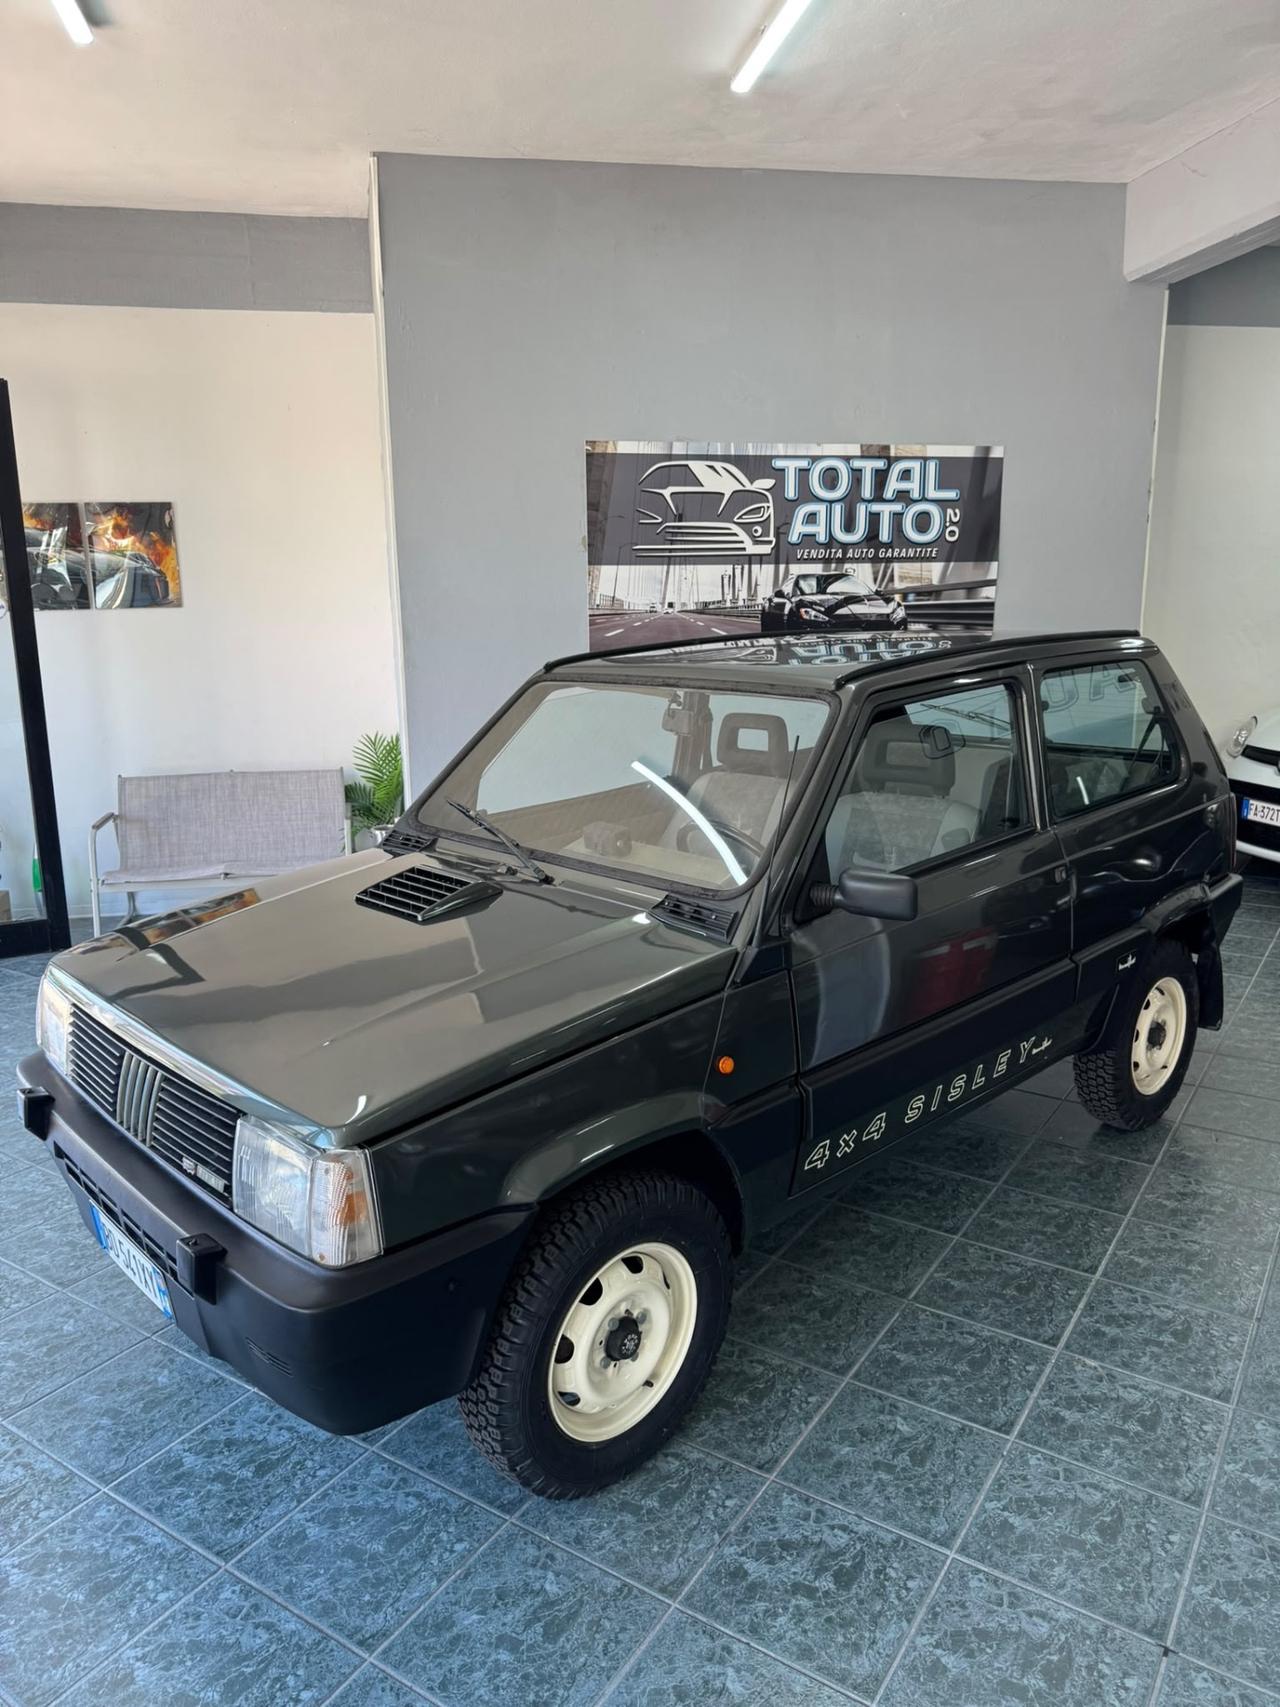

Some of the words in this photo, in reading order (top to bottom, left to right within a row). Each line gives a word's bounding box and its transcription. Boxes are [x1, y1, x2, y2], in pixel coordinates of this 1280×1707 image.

[771, 457, 960, 501] TOTAL
[787, 501, 944, 544] AUTO
[796, 548, 843, 560] VENDITA
[846, 548, 875, 559] AUTO
[878, 547, 939, 559] GARANTITE
[904, 1036, 1037, 1124] SISLEY
